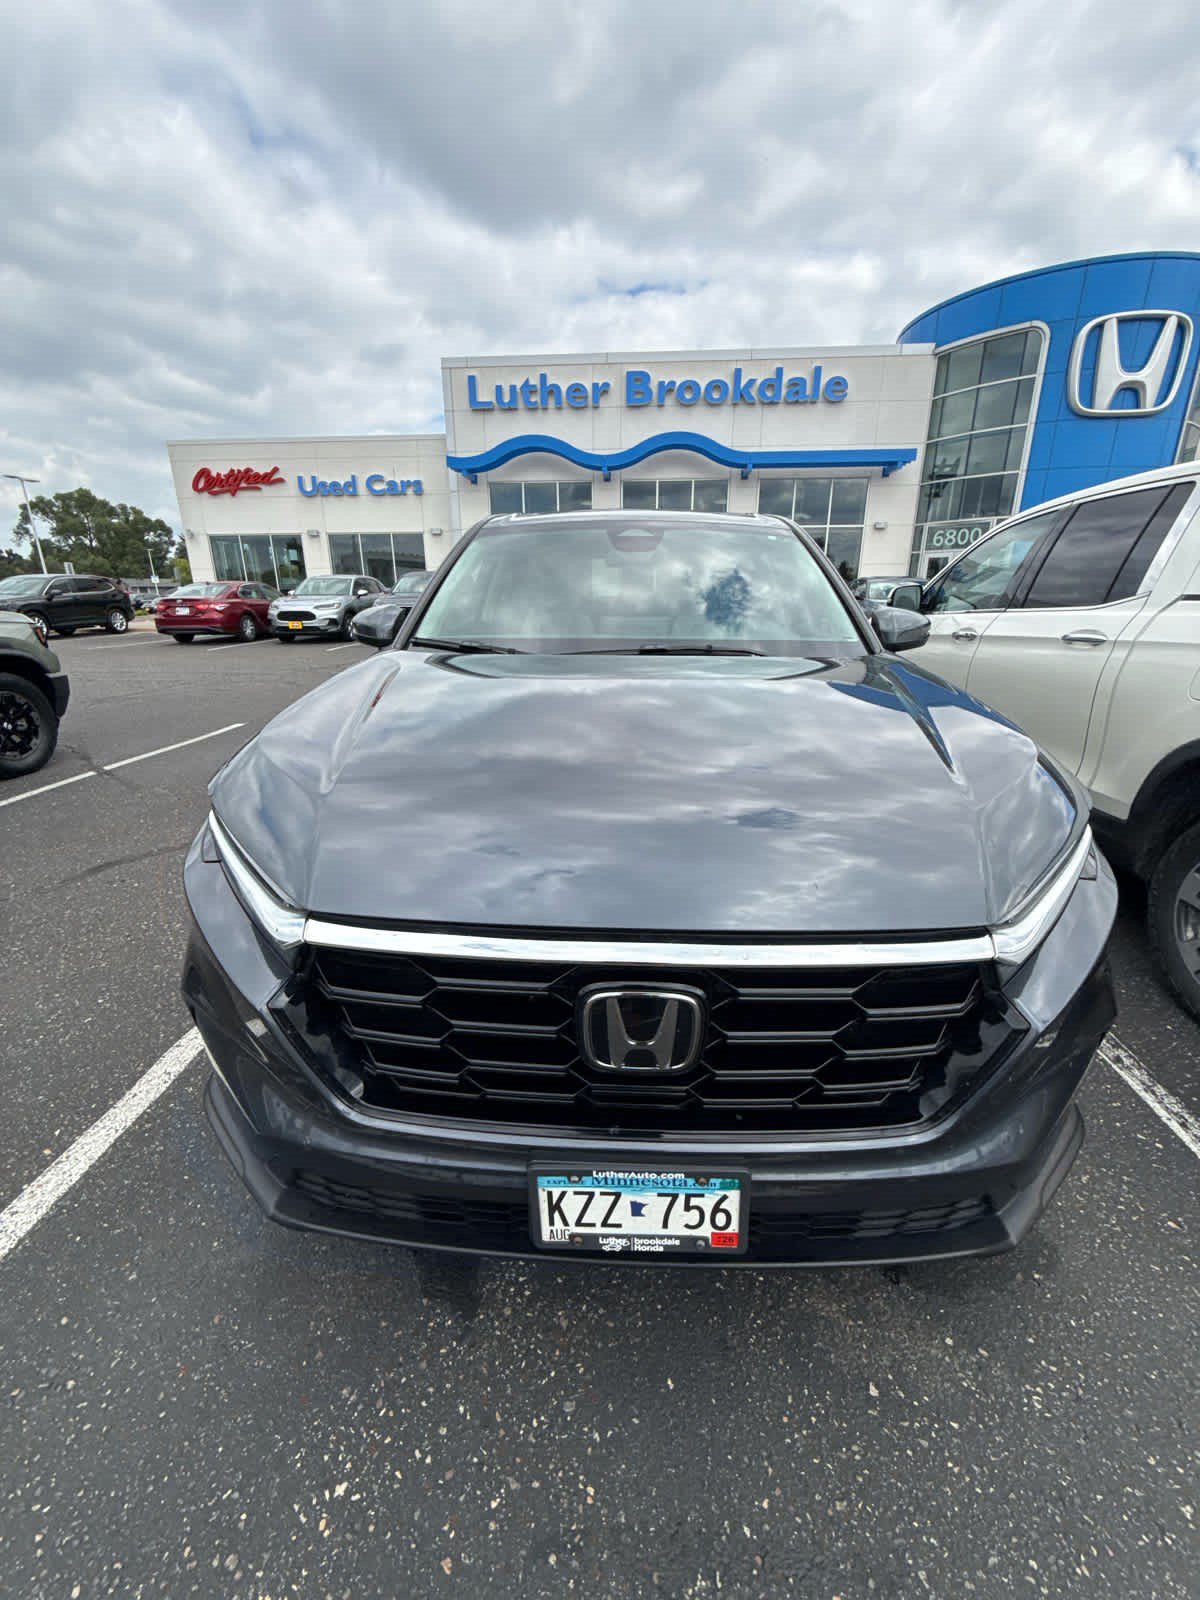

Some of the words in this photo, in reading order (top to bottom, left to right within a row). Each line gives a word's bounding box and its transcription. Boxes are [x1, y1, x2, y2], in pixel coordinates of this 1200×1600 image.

[467, 373, 610, 411] Luther
[625, 364, 849, 408] Brookdale
[191, 465, 286, 497] Certified
[297, 474, 357, 497] Used
[365, 473, 424, 496] Cars
[932, 527, 983, 547] 6800
[592, 1170, 685, 1180] LutherAuto.com
[546, 1190, 623, 1229] KZZ
[656, 1192, 733, 1232] 756
[549, 1228, 571, 1241] AUG
[634, 1237, 681, 1246] brookdale
[634, 1244, 665, 1253] Honda
